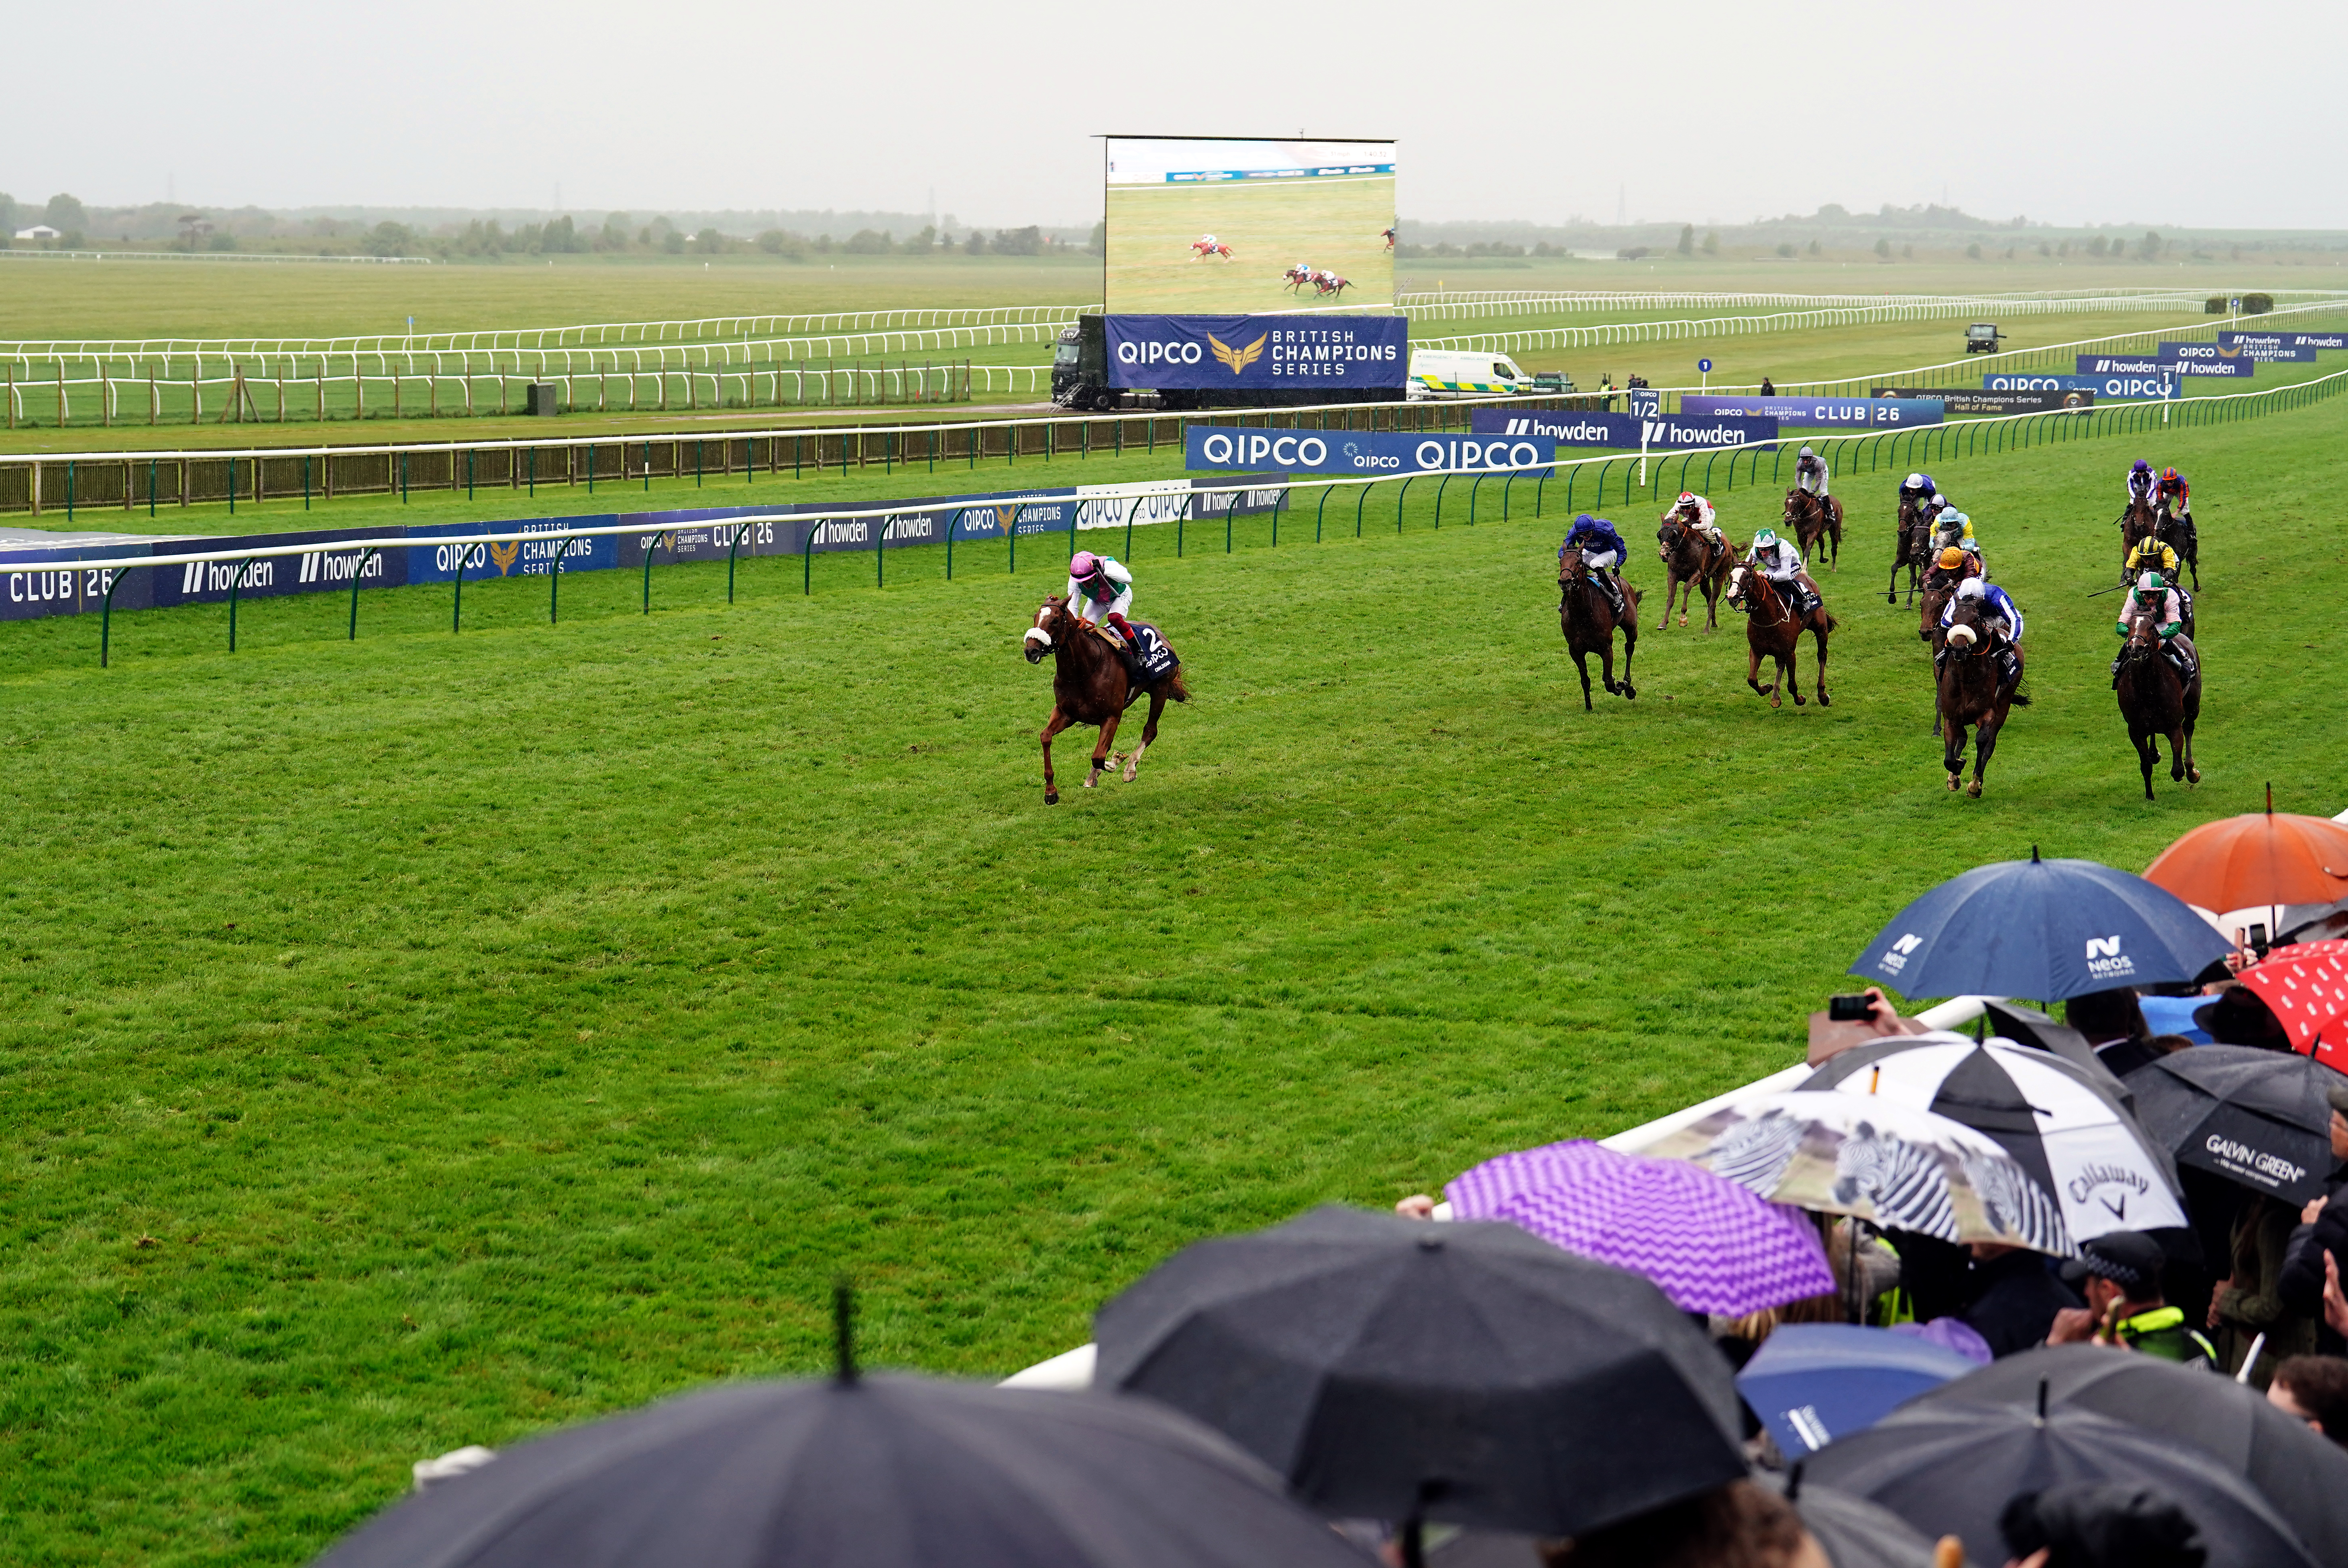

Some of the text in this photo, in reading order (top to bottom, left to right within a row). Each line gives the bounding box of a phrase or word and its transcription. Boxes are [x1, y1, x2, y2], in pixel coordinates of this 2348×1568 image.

[1272, 330, 1354, 343] BRITISH
[2246, 336, 2281, 344] howden
[2308, 336, 2342, 347] howden
[1118, 341, 1202, 364] QIPCO
[1272, 345, 1396, 361] CHAMPIONS
[2179, 347, 2215, 357] QIPCO
[2243, 349, 2296, 357] CHAMPIONS
[1272, 363, 1345, 375] SERIES
[2112, 361, 2156, 373] howden
[2191, 362, 2235, 374] howden
[1992, 377, 2059, 391] QIPCO
[2163, 372, 2169, 384] 1
[1973, 396, 2014, 404] Champions
[1633, 401, 1658, 417] 1/2
[1815, 406, 1900, 421] CLUB 26
[1534, 419, 1608, 440] howden
[1670, 423, 1745, 444] howden
[1204, 434, 1327, 466] QIPCO
[1416, 440, 1539, 469] QIPCO
[1354, 455, 1400, 468] QIPCO
[964, 508, 995, 531] QIPCO
[1018, 506, 1061, 523] CHAMPIONS
[828, 518, 868, 543] howden
[897, 512, 932, 538] howden
[1018, 524, 1044, 536] SERIES
[677, 534, 708, 544] CHAMPIONS
[713, 522, 773, 547] CLUB 26
[677, 544, 696, 553] SERIES
[524, 561, 564, 576] SERIS
[10, 569, 113, 602] CLUB 26
[1142, 628, 1163, 652] 2
[2206, 1134, 2257, 1165] GALVIN
[2069, 1161, 2150, 1205] Callaway
